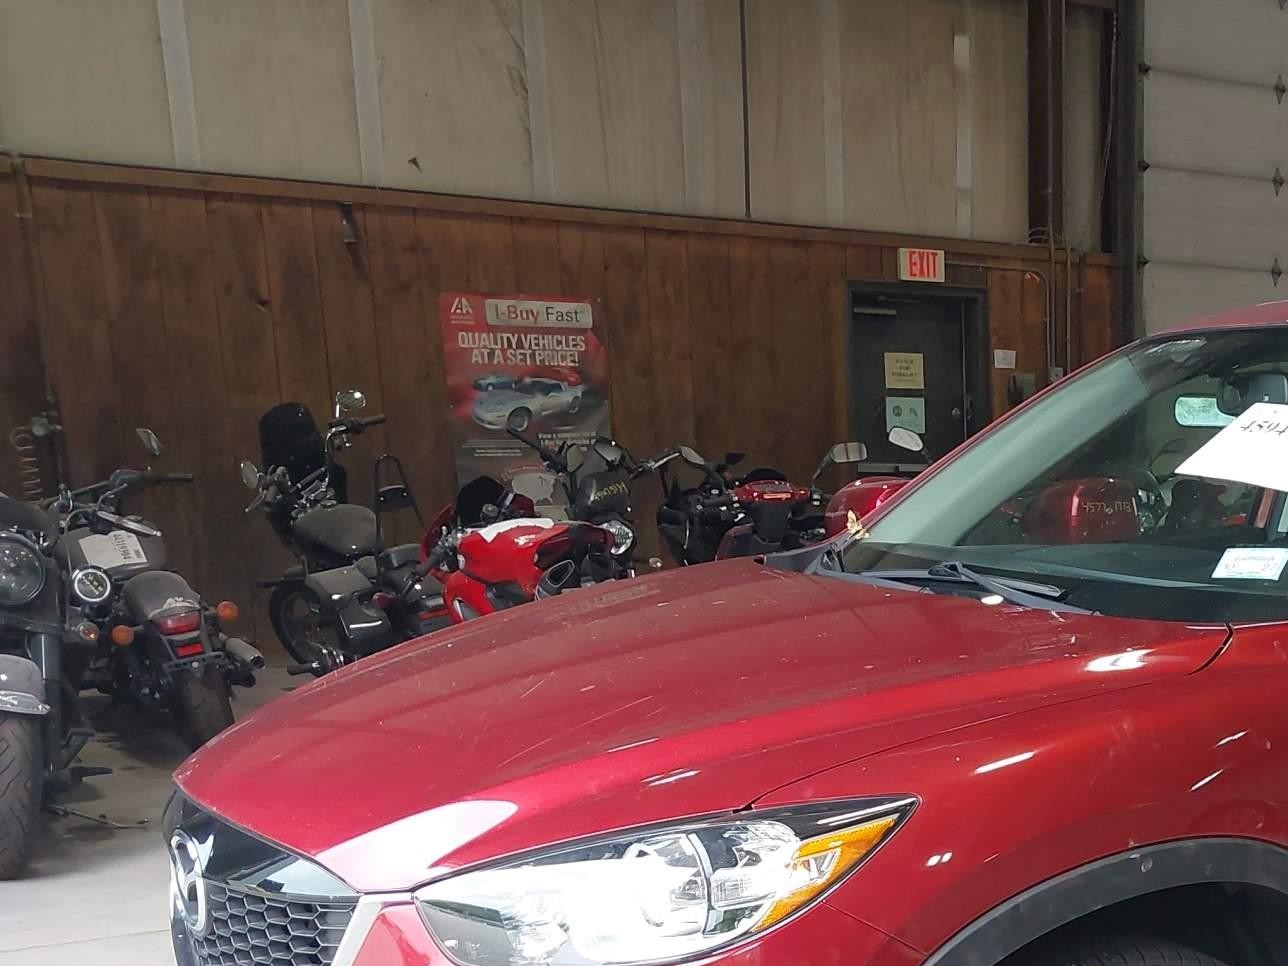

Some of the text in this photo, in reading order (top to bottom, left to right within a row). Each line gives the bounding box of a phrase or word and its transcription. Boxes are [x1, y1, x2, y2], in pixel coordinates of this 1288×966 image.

[908, 250, 938, 279] EXIT
[494, 303, 540, 324] I-Buy
[545, 306, 580, 323] Fast
[457, 331, 586, 351] QUALITY VEHICLES
[471, 349, 580, 367] AT A SET PRICE!
